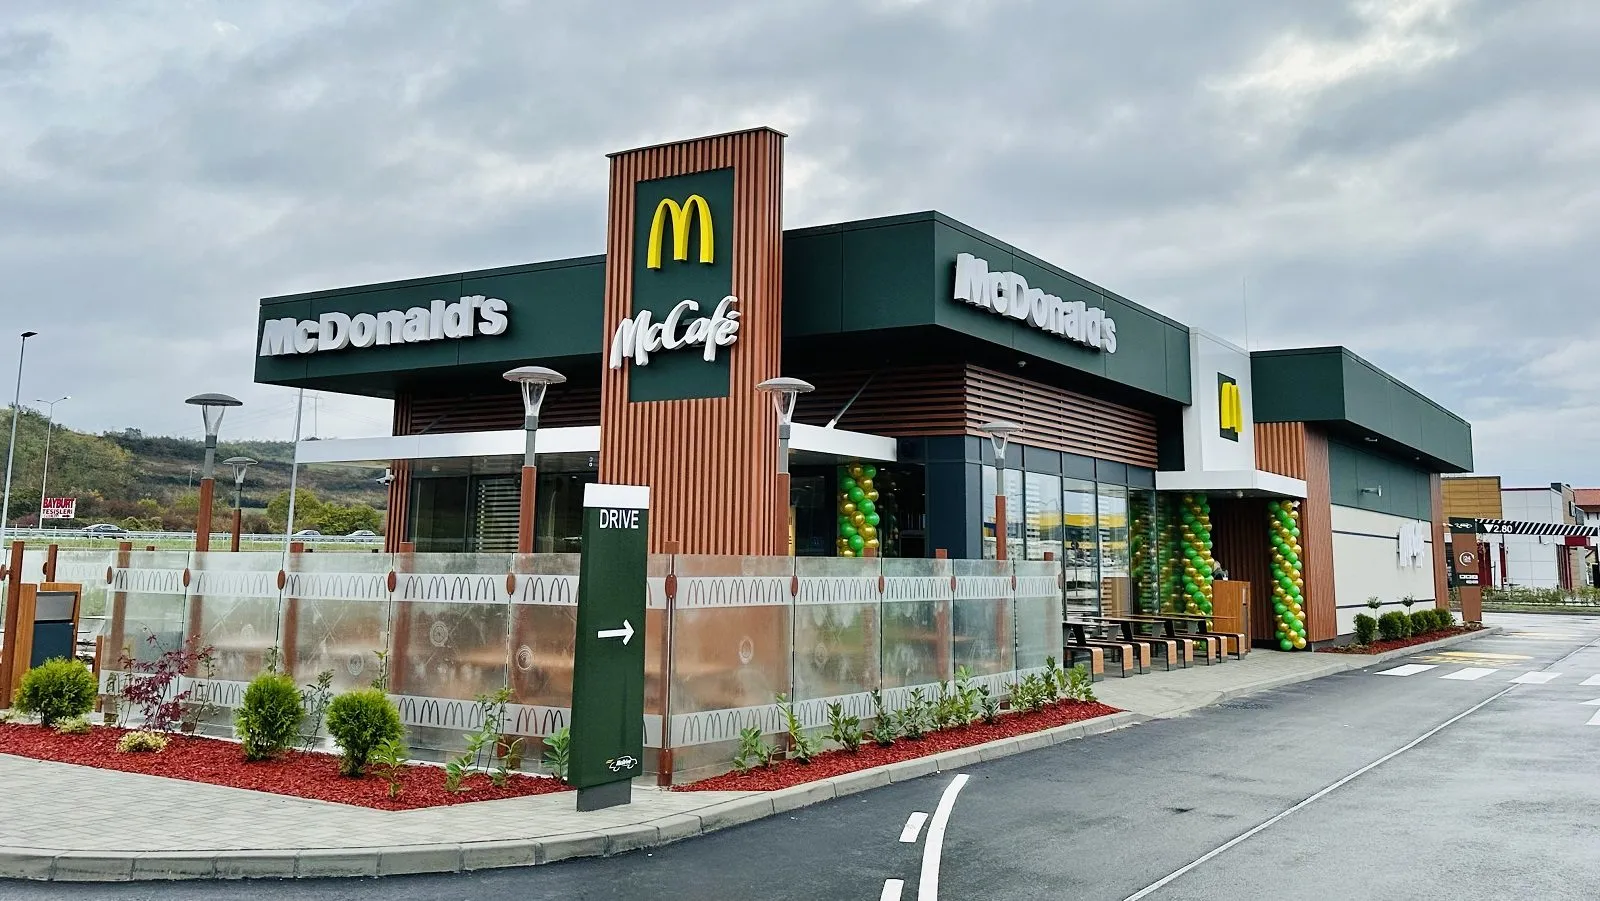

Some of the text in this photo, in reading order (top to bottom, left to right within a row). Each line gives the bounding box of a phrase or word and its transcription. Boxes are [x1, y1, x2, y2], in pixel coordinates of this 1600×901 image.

[954, 252, 1117, 354] McDonald's
[259, 295, 509, 357] McDonald's
[609, 295, 741, 370] McCafé
[43, 497, 75, 508] BAYBURT
[600, 509, 640, 529] DRIVE
[1493, 525, 1513, 533] 2.80
